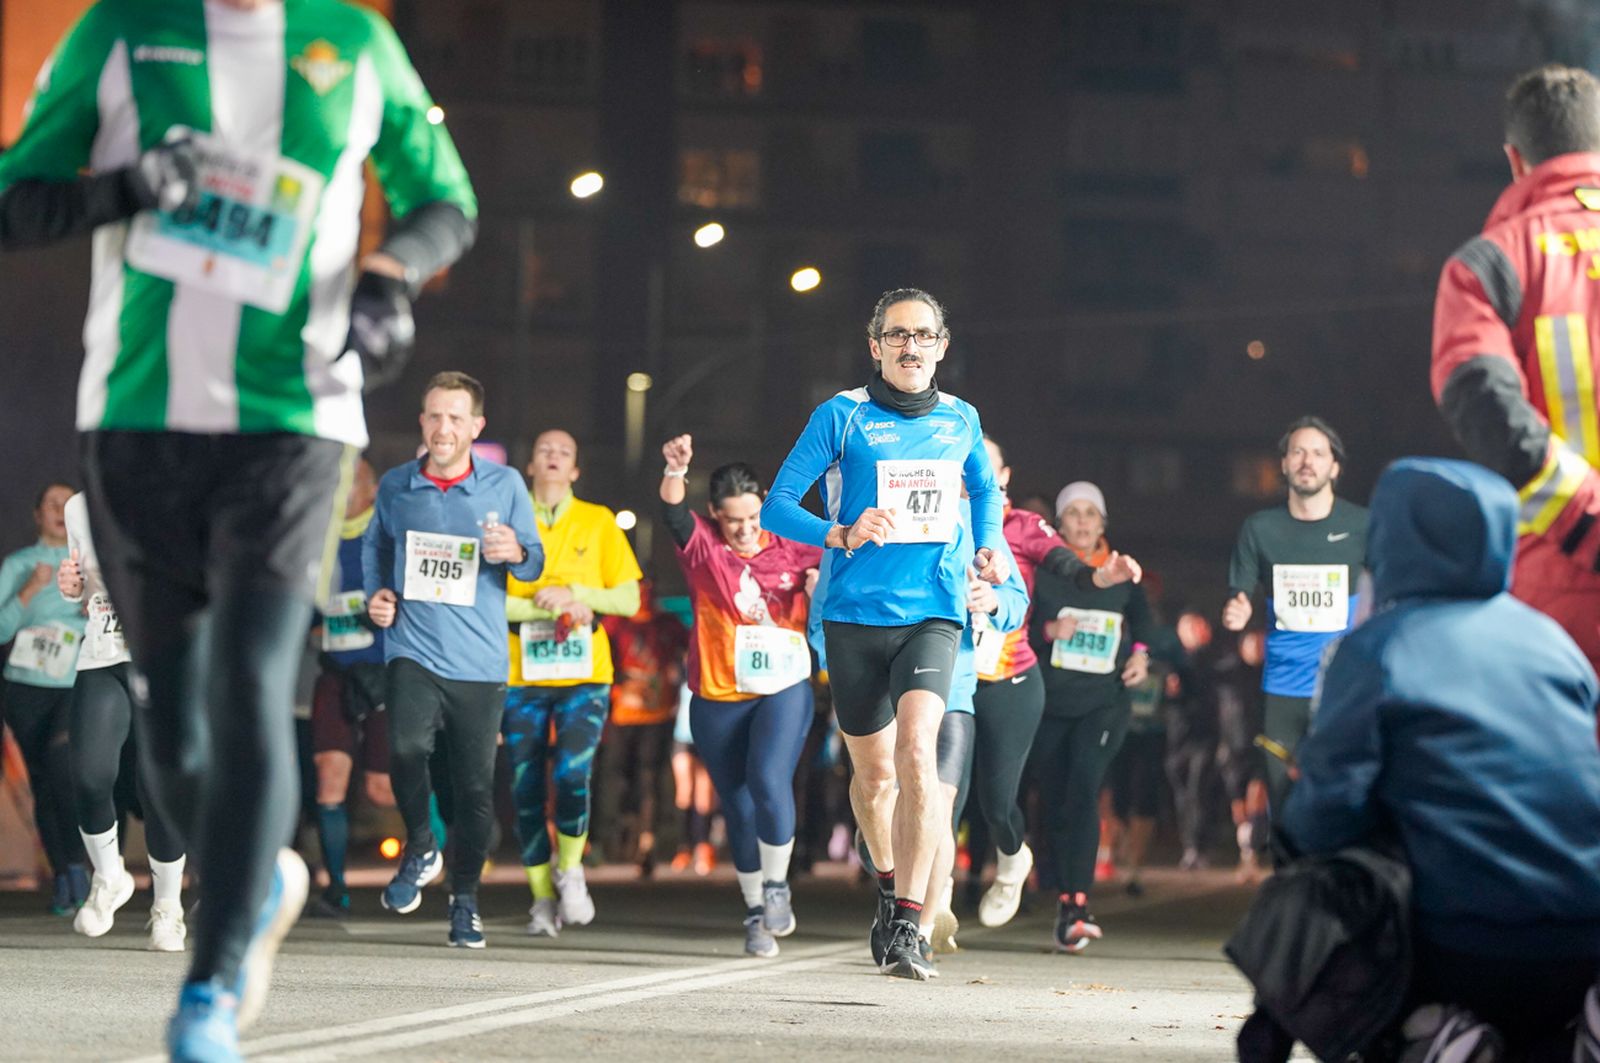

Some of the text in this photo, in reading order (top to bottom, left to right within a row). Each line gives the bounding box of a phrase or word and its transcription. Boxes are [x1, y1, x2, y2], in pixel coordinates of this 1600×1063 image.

[888, 479, 906, 488] SAN
[906, 490, 943, 514] 477
[419, 558, 463, 580] 4795
[1288, 590, 1334, 607] 3003
